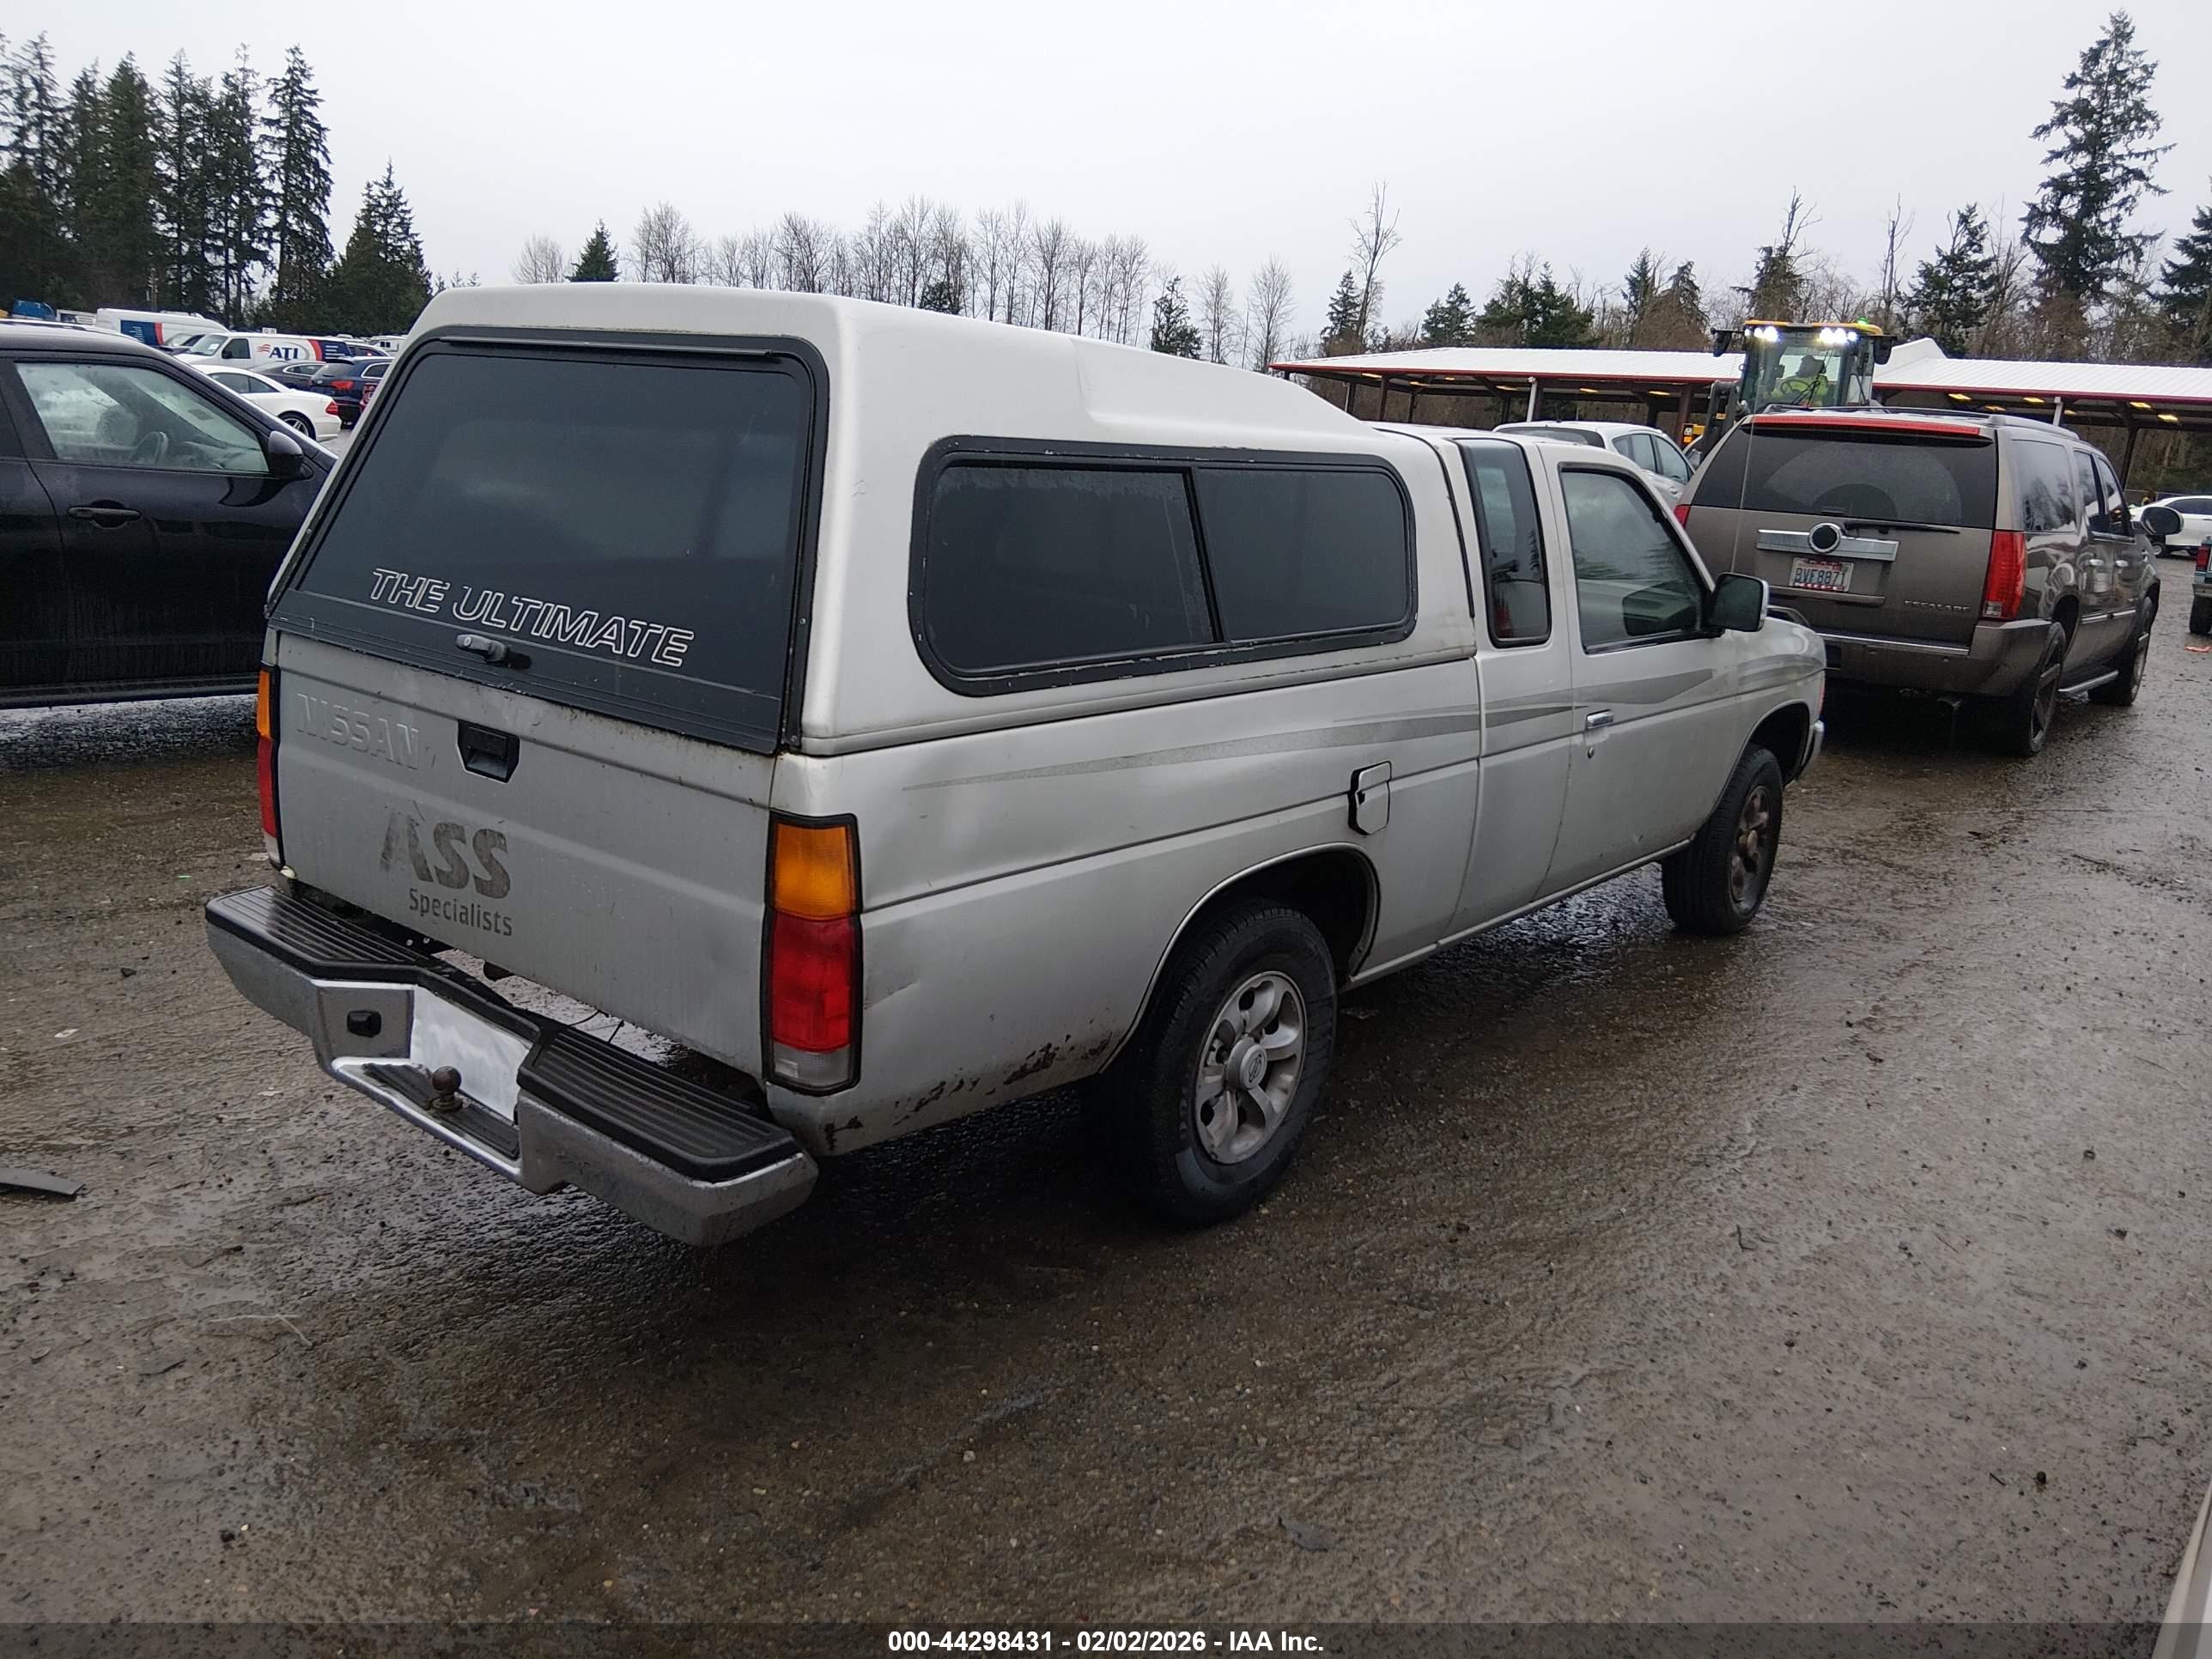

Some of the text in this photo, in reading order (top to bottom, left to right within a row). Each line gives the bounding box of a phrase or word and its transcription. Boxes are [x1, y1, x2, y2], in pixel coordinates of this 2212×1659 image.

[270, 346, 299, 361] ATI
[371, 568, 694, 666] THE ULTIMATE
[296, 693, 419, 769] NISSAN
[410, 887, 514, 937] Specialists
